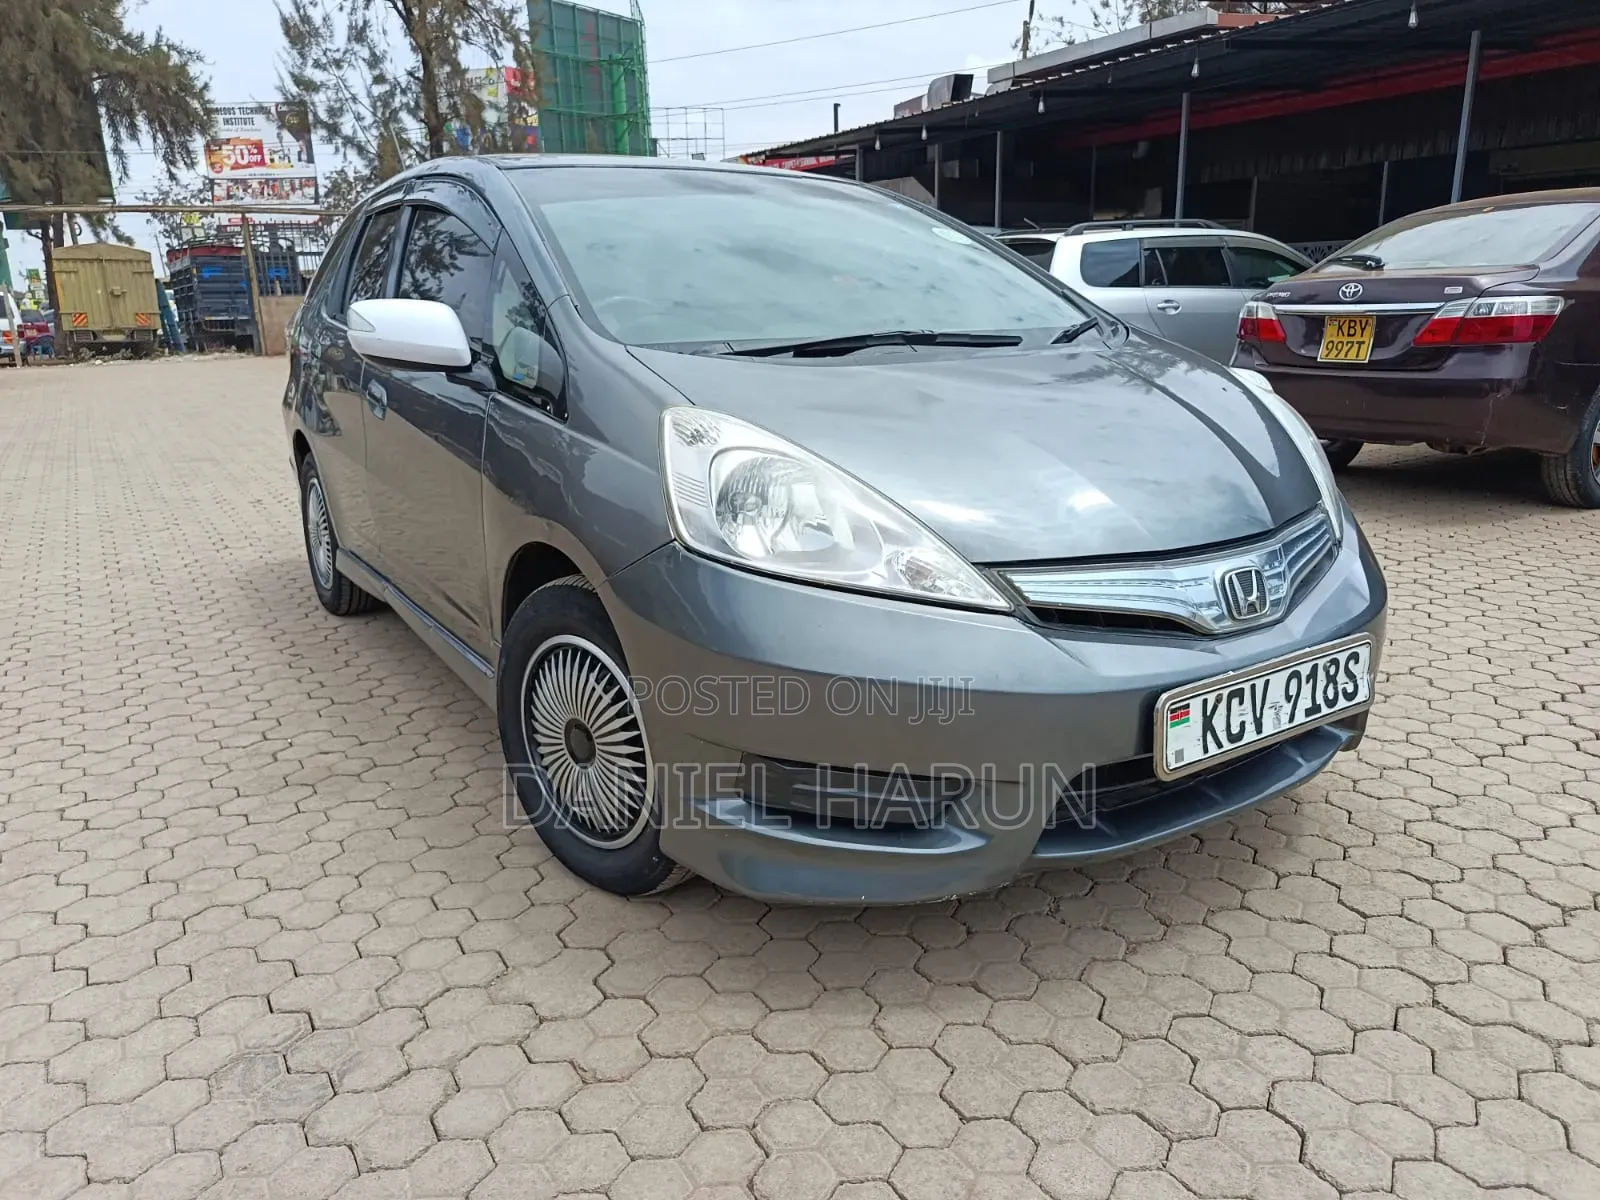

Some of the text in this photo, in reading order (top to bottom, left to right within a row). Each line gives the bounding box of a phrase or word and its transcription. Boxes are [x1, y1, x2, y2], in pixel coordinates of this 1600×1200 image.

[223, 117, 255, 126] INSTITUTE
[249, 154, 262, 163] OFF
[1336, 319, 1369, 338] KBY
[1325, 340, 1366, 358] 997T
[1202, 651, 1360, 755] KCV 918S
